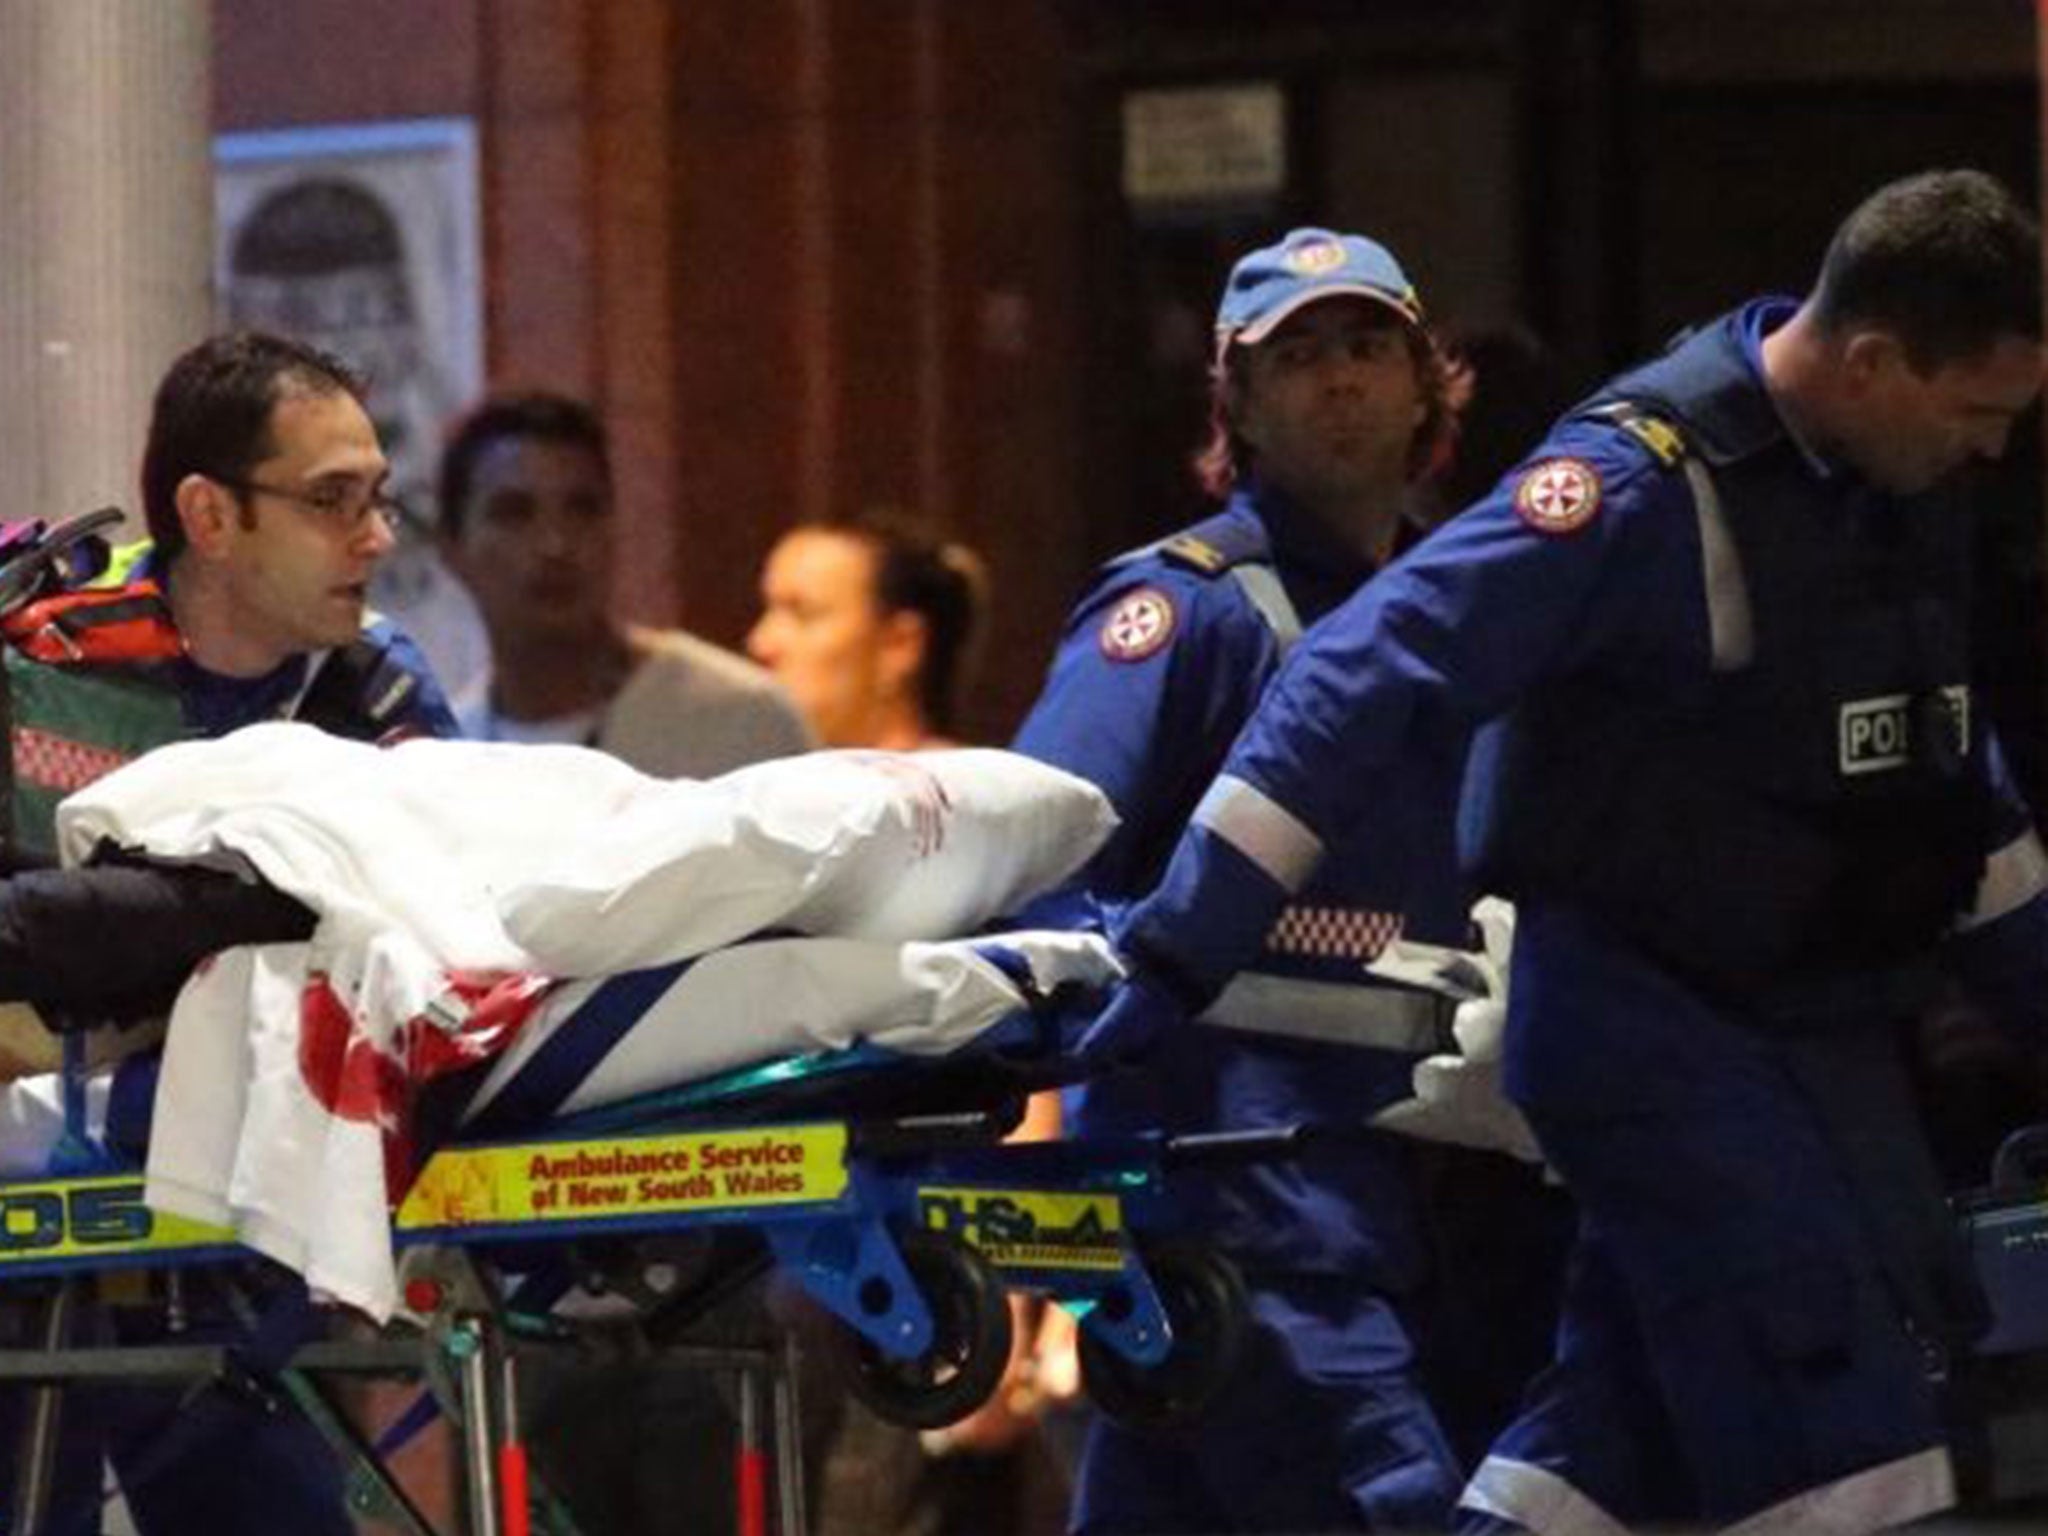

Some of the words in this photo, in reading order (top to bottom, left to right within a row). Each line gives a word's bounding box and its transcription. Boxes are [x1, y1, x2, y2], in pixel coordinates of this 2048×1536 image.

[530, 1147, 690, 1180] Ambulance
[700, 1137, 804, 1170] Service
[531, 1182, 558, 1209] of
[567, 1182, 628, 1206] New
[638, 1173, 715, 1202] South
[724, 1169, 804, 1195] Wales
